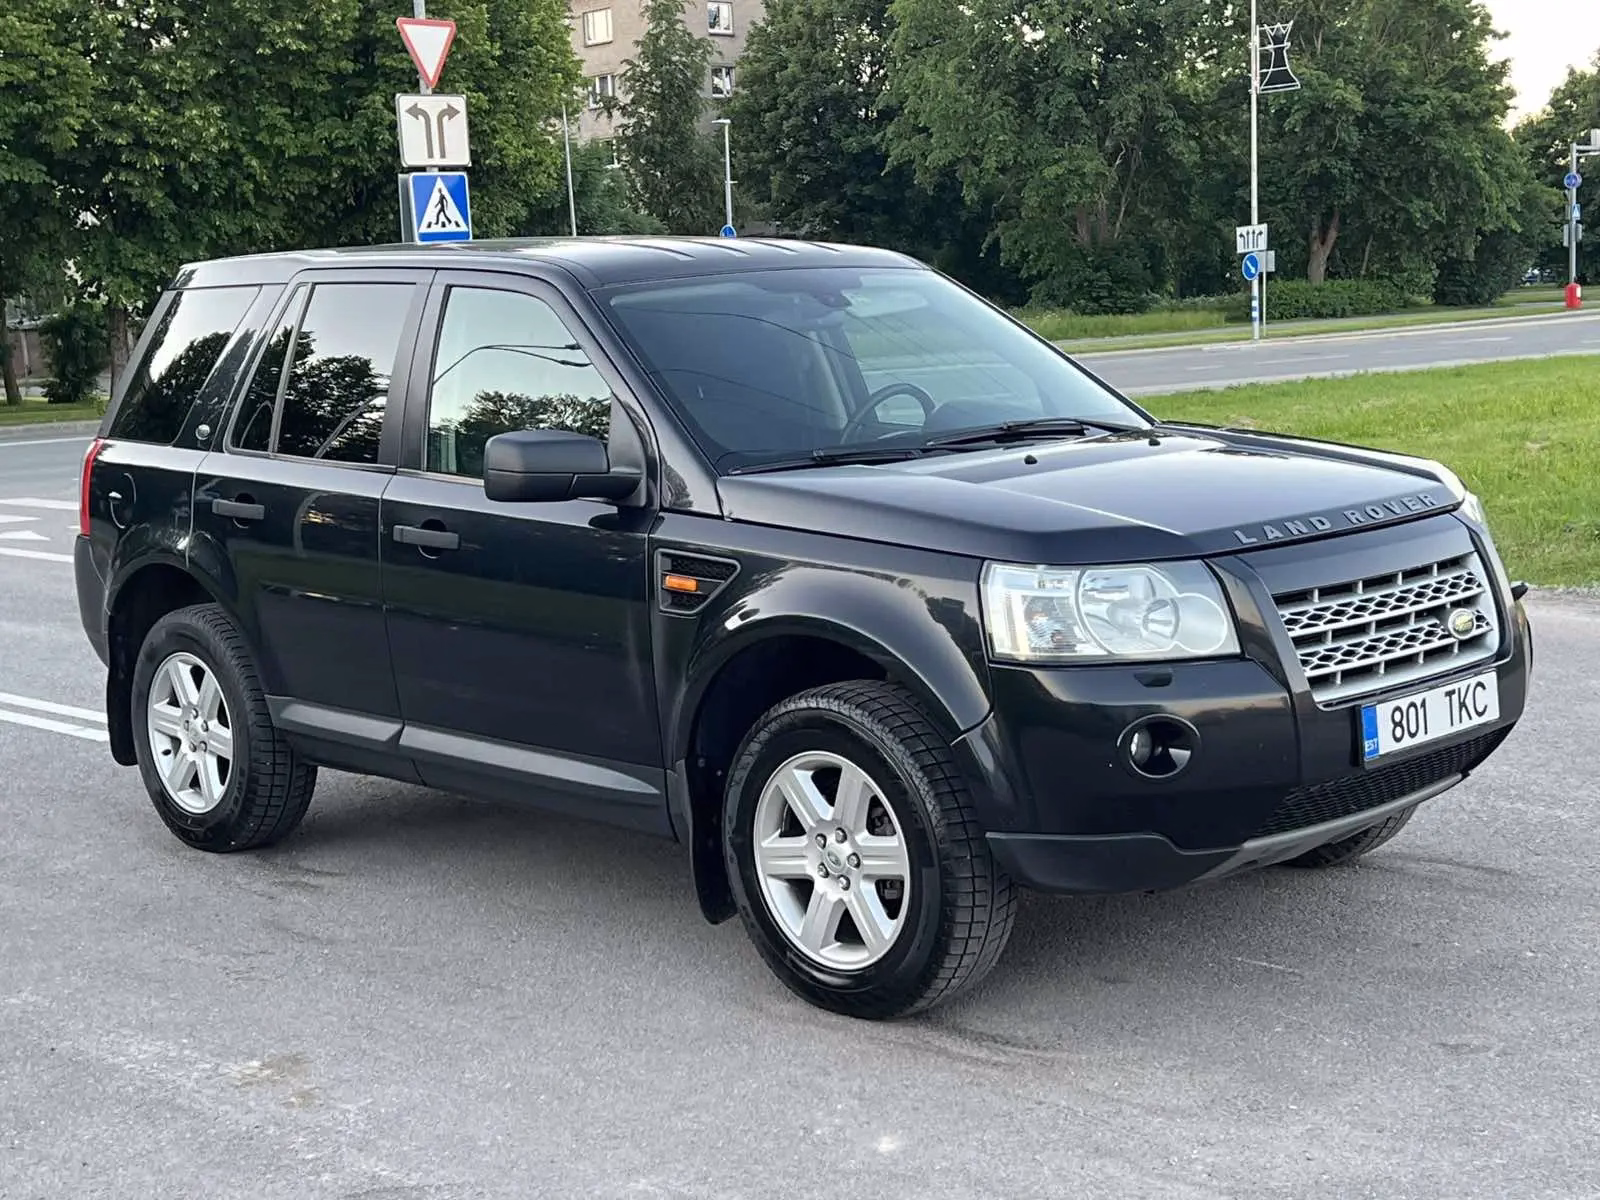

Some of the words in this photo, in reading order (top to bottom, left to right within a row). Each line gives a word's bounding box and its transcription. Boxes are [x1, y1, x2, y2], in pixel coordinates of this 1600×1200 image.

[1233, 516, 1332, 544] LAND
[1343, 493, 1437, 524] ROVER
[1390, 698, 1428, 743] 801
[1444, 681, 1488, 727] TKC
